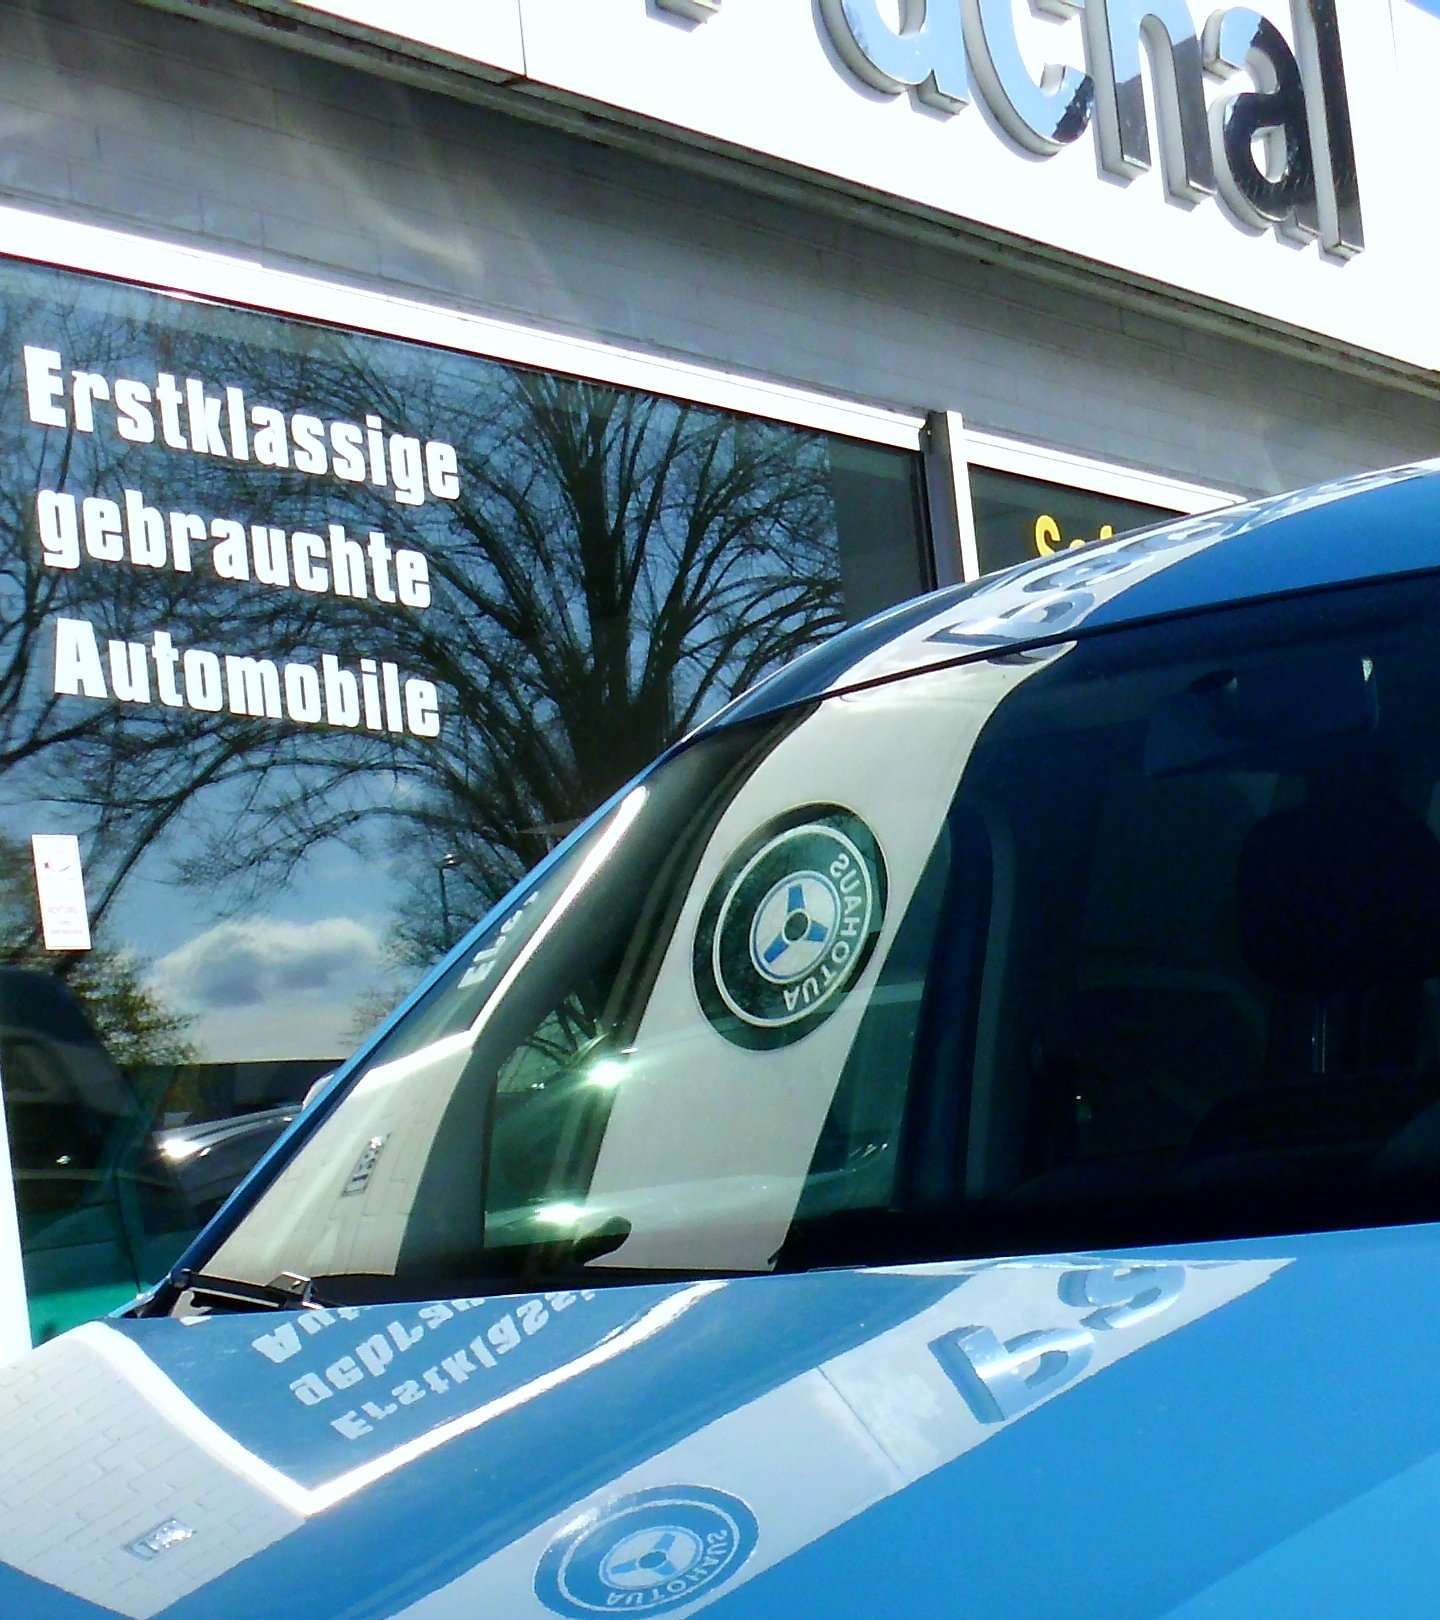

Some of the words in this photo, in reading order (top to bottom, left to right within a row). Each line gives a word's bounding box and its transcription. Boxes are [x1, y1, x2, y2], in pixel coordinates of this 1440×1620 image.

[23, 345, 461, 506] Erstklassige
[36, 488, 433, 609] gebrauchte
[54, 618, 441, 738] Automobile
